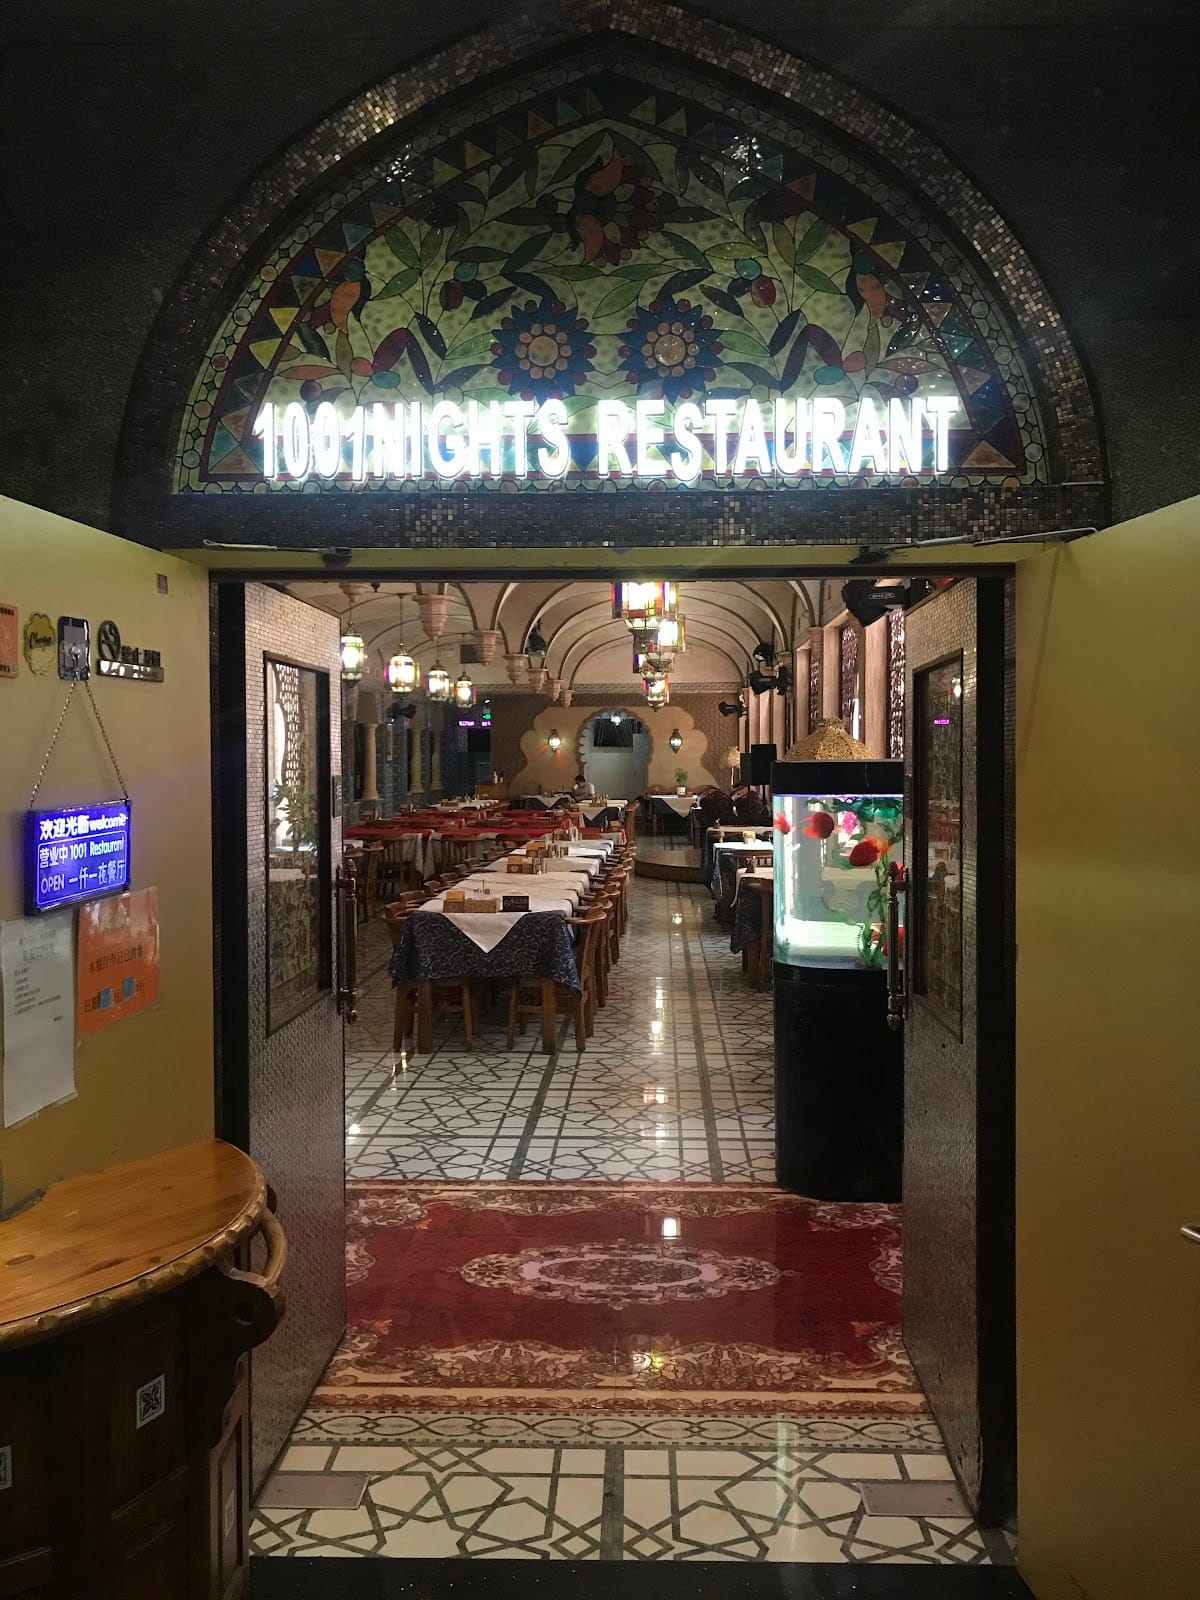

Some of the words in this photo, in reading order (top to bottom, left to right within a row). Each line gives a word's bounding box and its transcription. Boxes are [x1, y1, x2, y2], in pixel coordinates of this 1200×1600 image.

[597, 396, 959, 481] RESTAURANT
[40, 815, 89, 840] 欢迎光临
[89, 813, 128, 831] welcome
[40, 845, 68, 868] 营业中
[70, 842, 87, 860] 1001
[90, 836, 124, 856] Restaurant
[41, 874, 65, 893] OPEN
[69, 860, 125, 889] 一仟一夜餐厅
